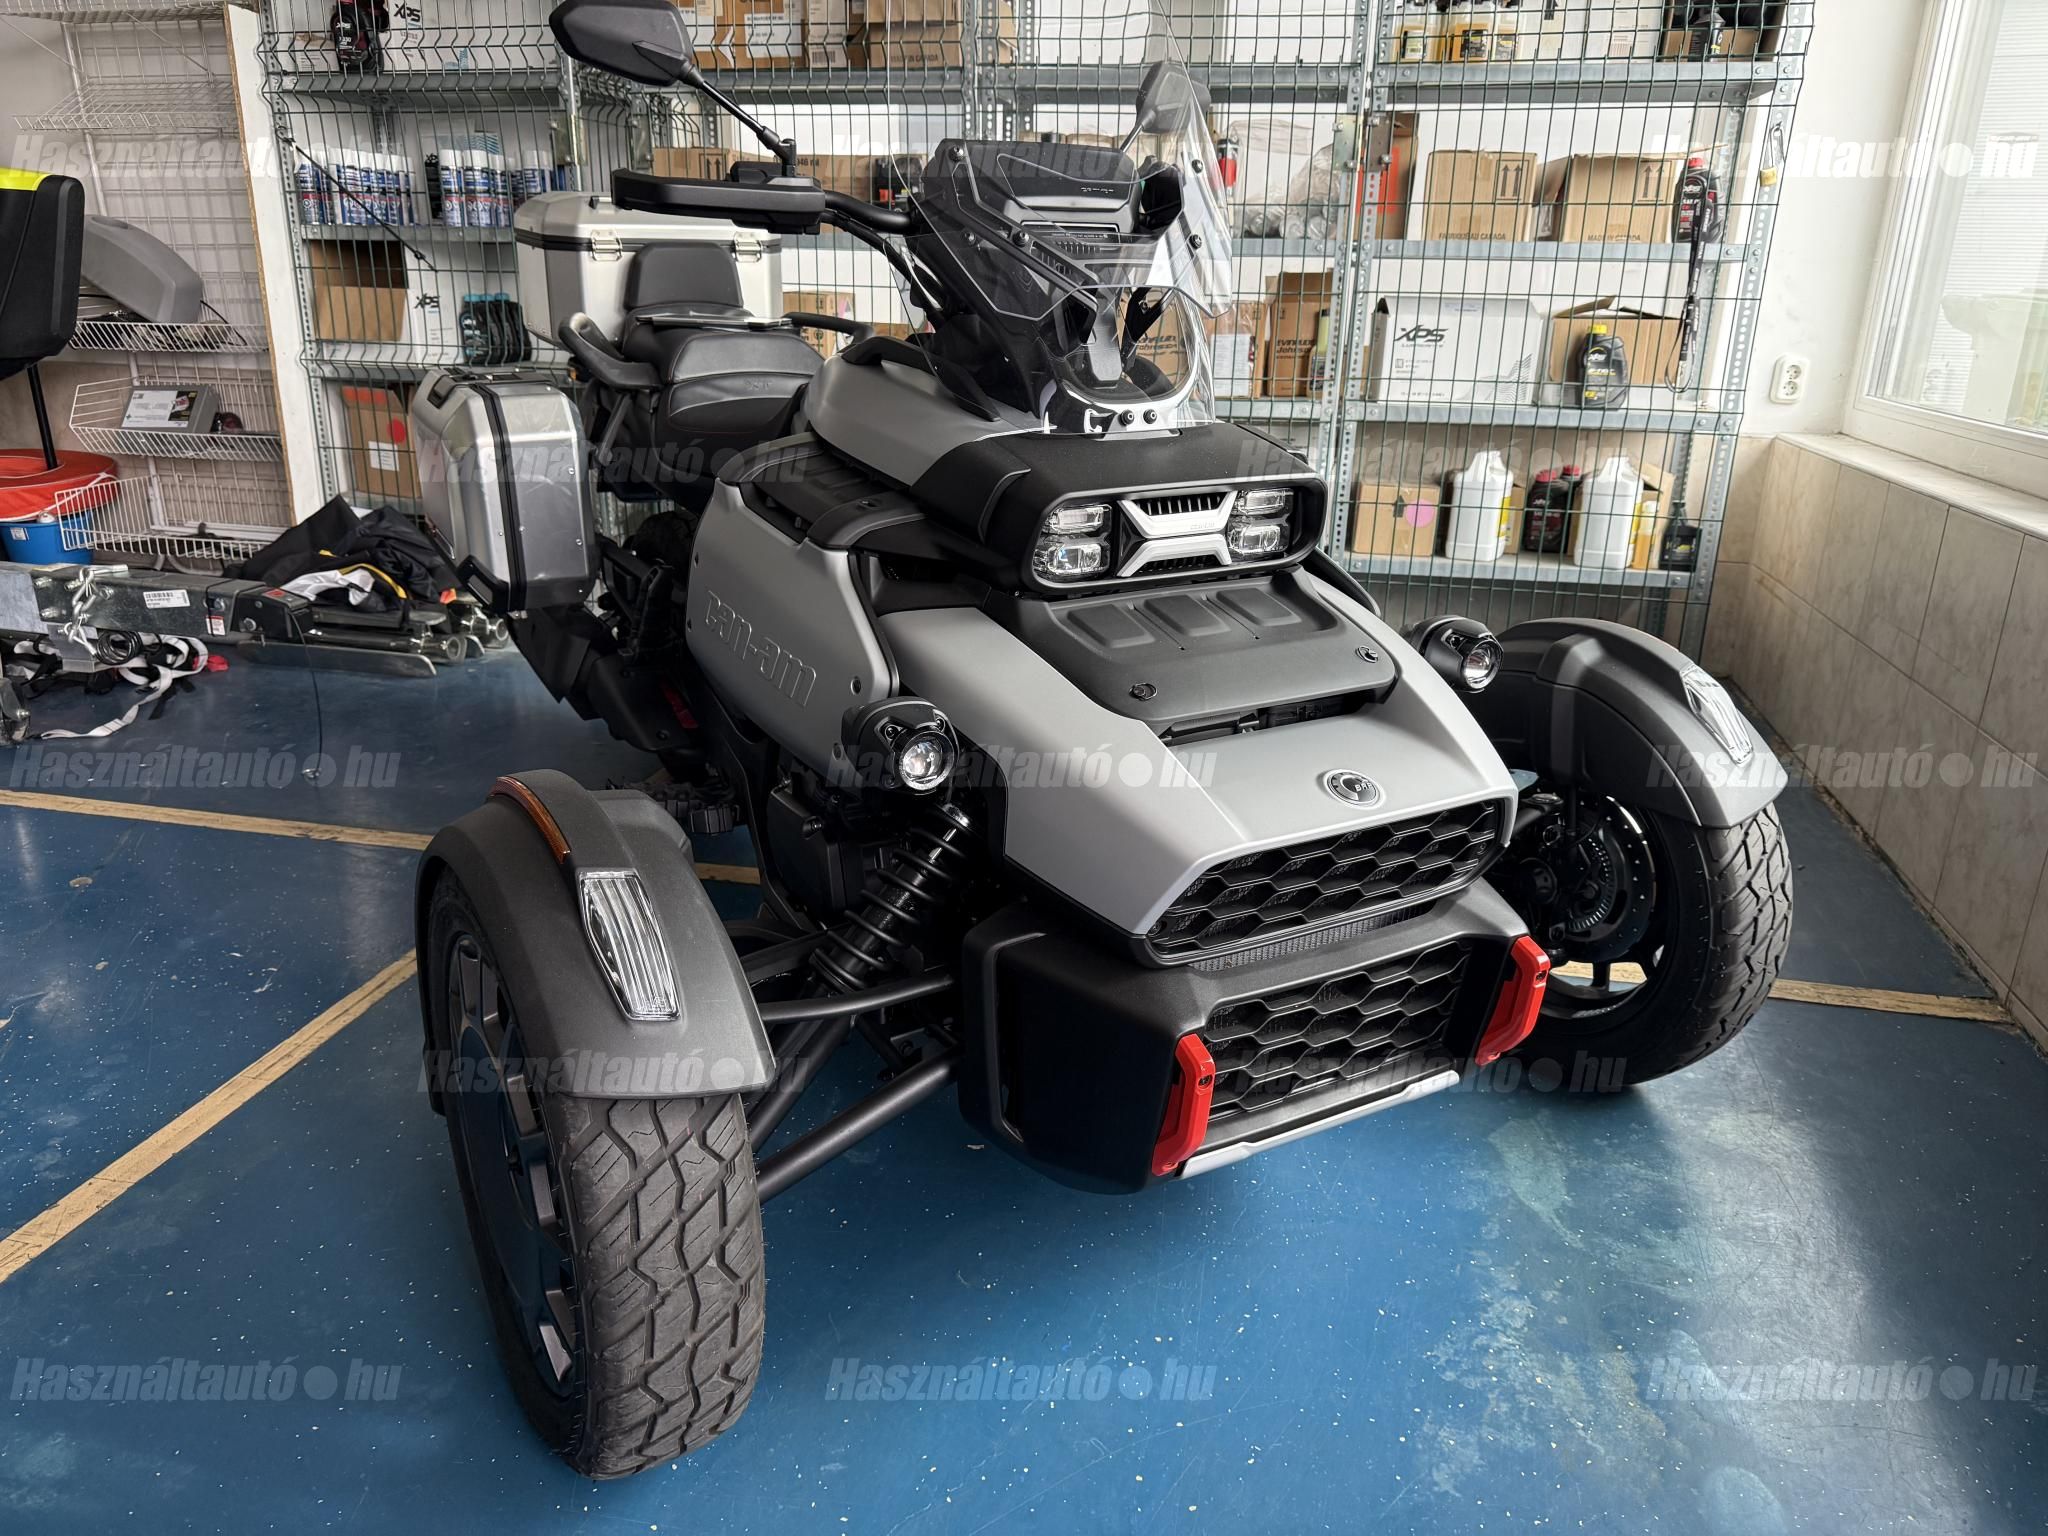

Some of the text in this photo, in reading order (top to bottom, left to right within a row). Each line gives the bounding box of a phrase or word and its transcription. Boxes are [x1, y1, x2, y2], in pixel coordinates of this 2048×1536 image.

[393, 3, 421, 22] XPS
[1481, 231, 1506, 240] CAADA
[1393, 325, 1449, 342] XPS
